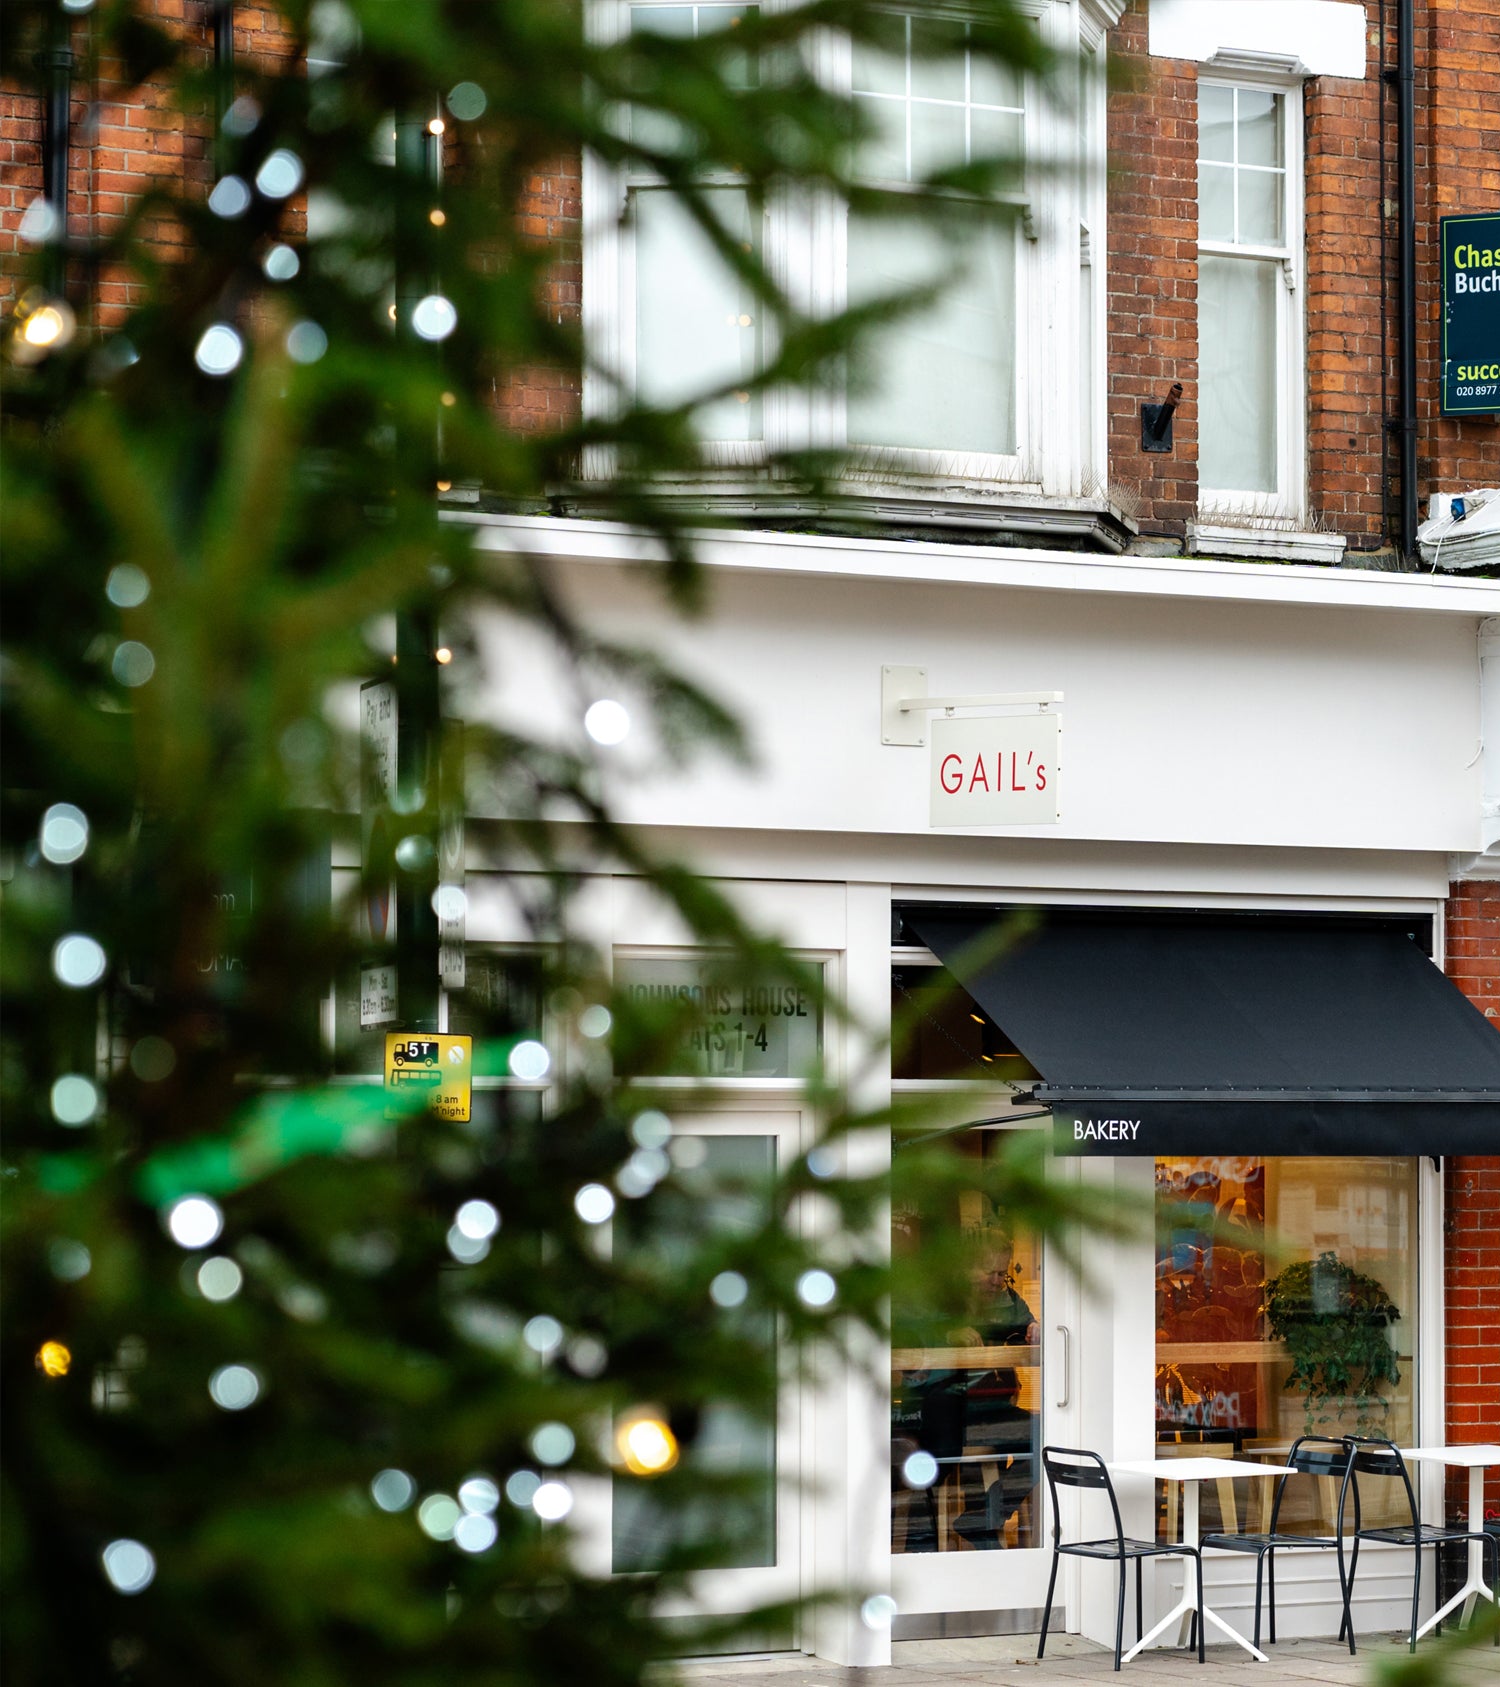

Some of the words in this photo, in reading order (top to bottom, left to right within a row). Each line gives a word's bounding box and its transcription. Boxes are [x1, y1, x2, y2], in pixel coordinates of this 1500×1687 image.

[1456, 386, 1474, 396] 020
[1475, 385, 1497, 395] 8977
[940, 750, 1047, 794] GAIL's
[742, 986, 808, 1017] HOUSE
[733, 1022, 768, 1052] 1-4
[1074, 1119, 1141, 1140] BAKERY
